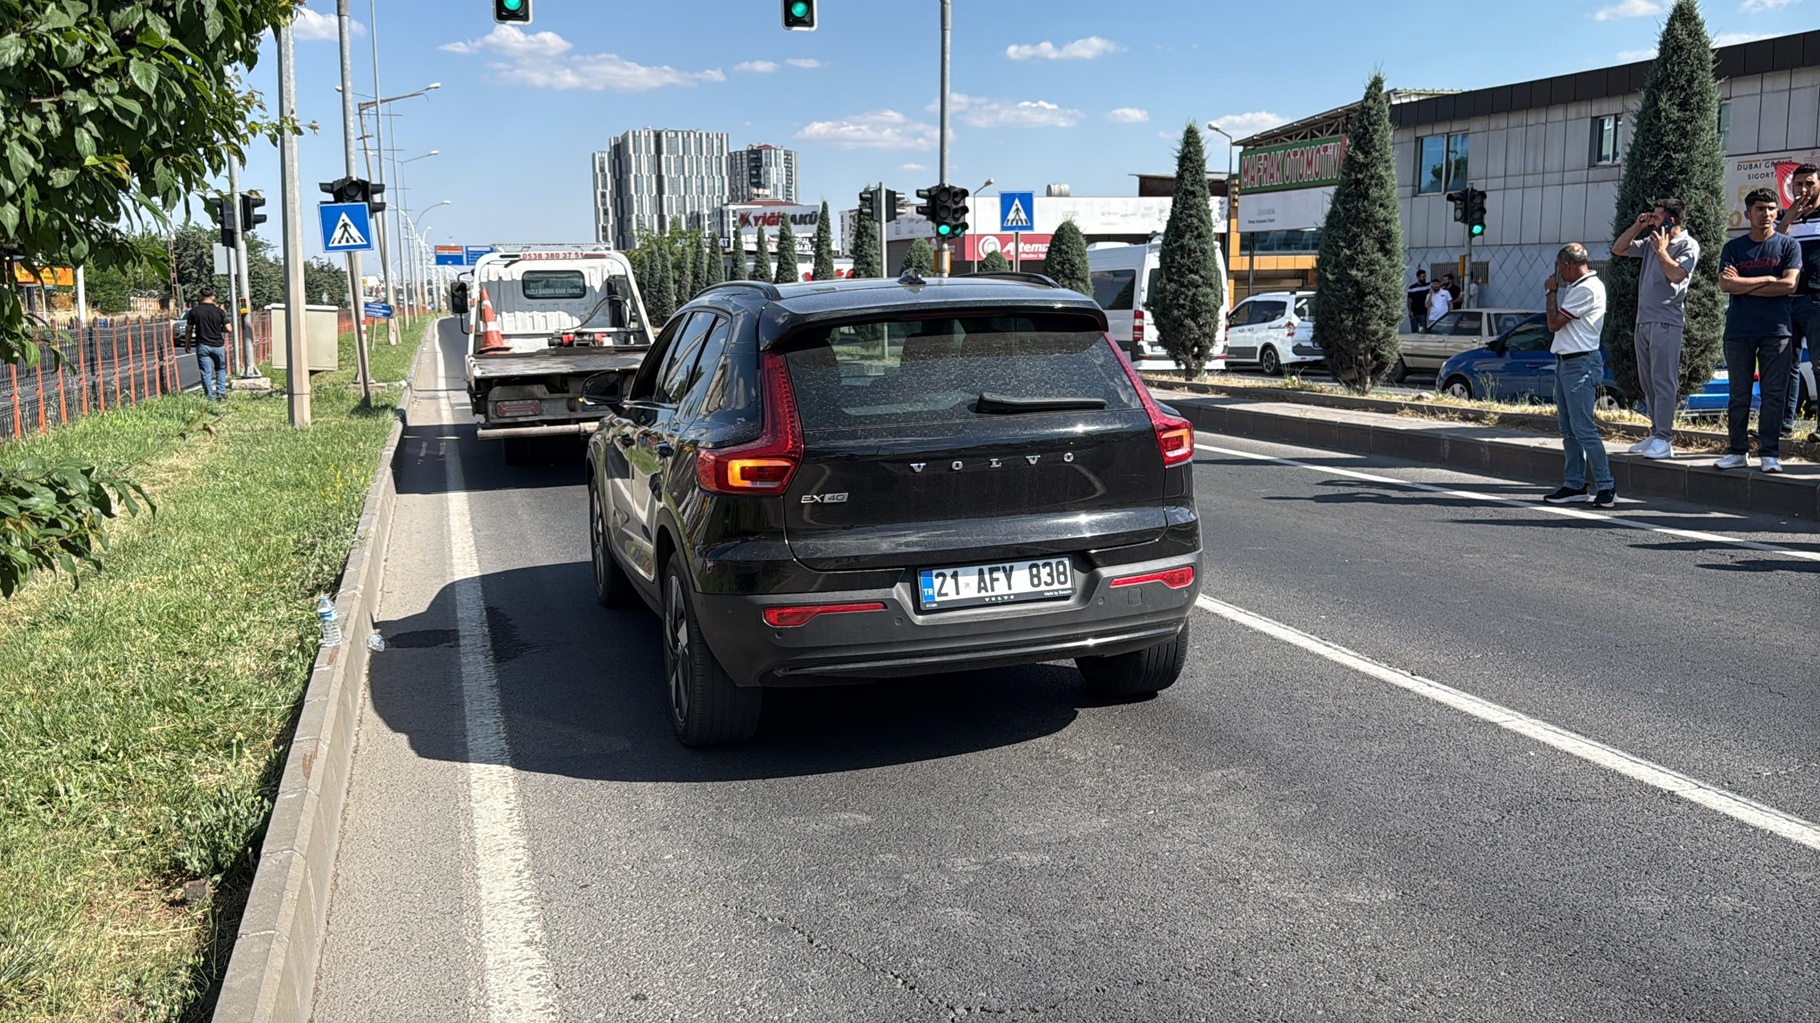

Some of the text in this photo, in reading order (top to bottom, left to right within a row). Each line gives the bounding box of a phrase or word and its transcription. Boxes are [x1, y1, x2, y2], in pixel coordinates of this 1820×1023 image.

[1241, 142, 1341, 189] MAFRAK OTOMOTİV
[1736, 163, 1762, 171] DUBAI
[1747, 171, 1777, 180] SIGORT
[753, 211, 782, 227] YİĞİ
[522, 252, 543, 260] 0538
[909, 452, 1075, 473] VOLVO
[934, 560, 1069, 597] 21 AFY 838
[923, 588, 934, 596] TR
